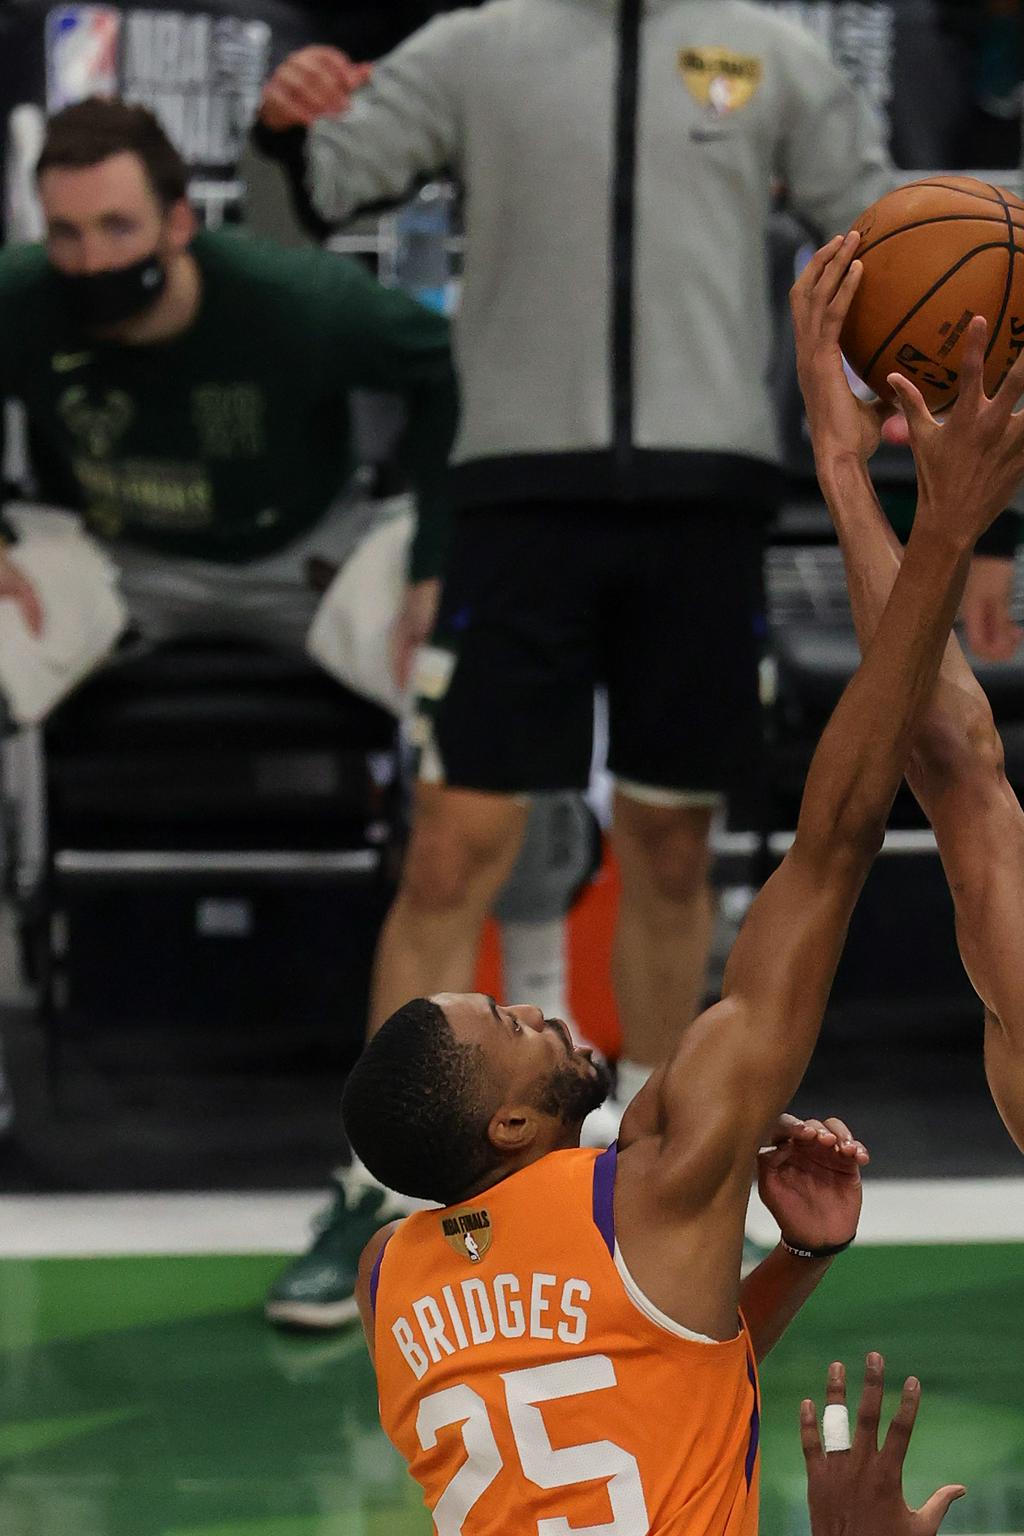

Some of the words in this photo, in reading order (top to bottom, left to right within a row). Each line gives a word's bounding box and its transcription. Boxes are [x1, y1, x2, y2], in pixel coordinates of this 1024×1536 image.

[442, 1217, 461, 1236] NBA
[459, 1210, 490, 1233] FINALS
[391, 1273, 591, 1381] BRIDGES
